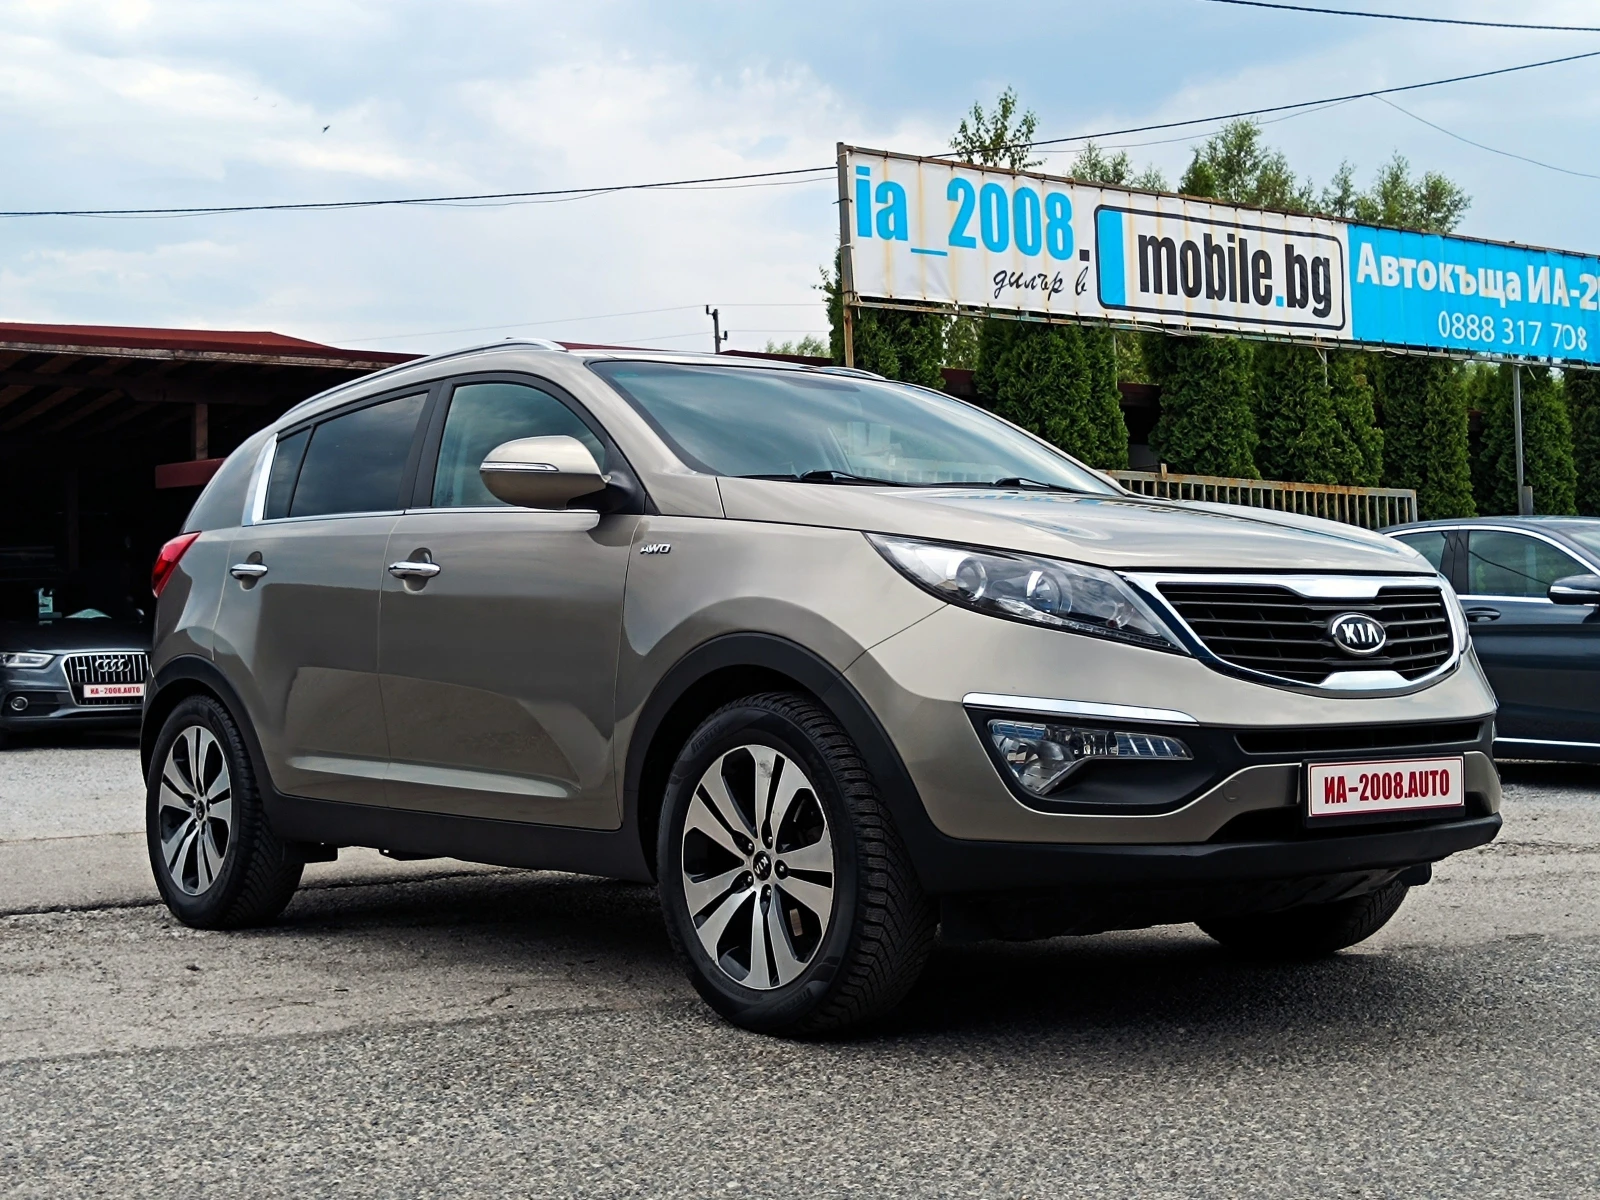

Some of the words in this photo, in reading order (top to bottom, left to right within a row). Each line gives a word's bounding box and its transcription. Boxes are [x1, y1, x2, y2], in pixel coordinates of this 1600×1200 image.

[993, 269, 1063, 300] дилър
[1138, 234, 1331, 318] mobile.bg
[1357, 242, 1521, 308] Автокъща
[1527, 265, 1600, 312] ИА-2
[1438, 311, 1495, 342] 0888
[1502, 319, 1541, 346] 317
[1551, 322, 1587, 351] 708
[640, 543, 671, 554] AWD
[1341, 623, 1379, 643] KIA
[754, 856, 769, 875] KIA
